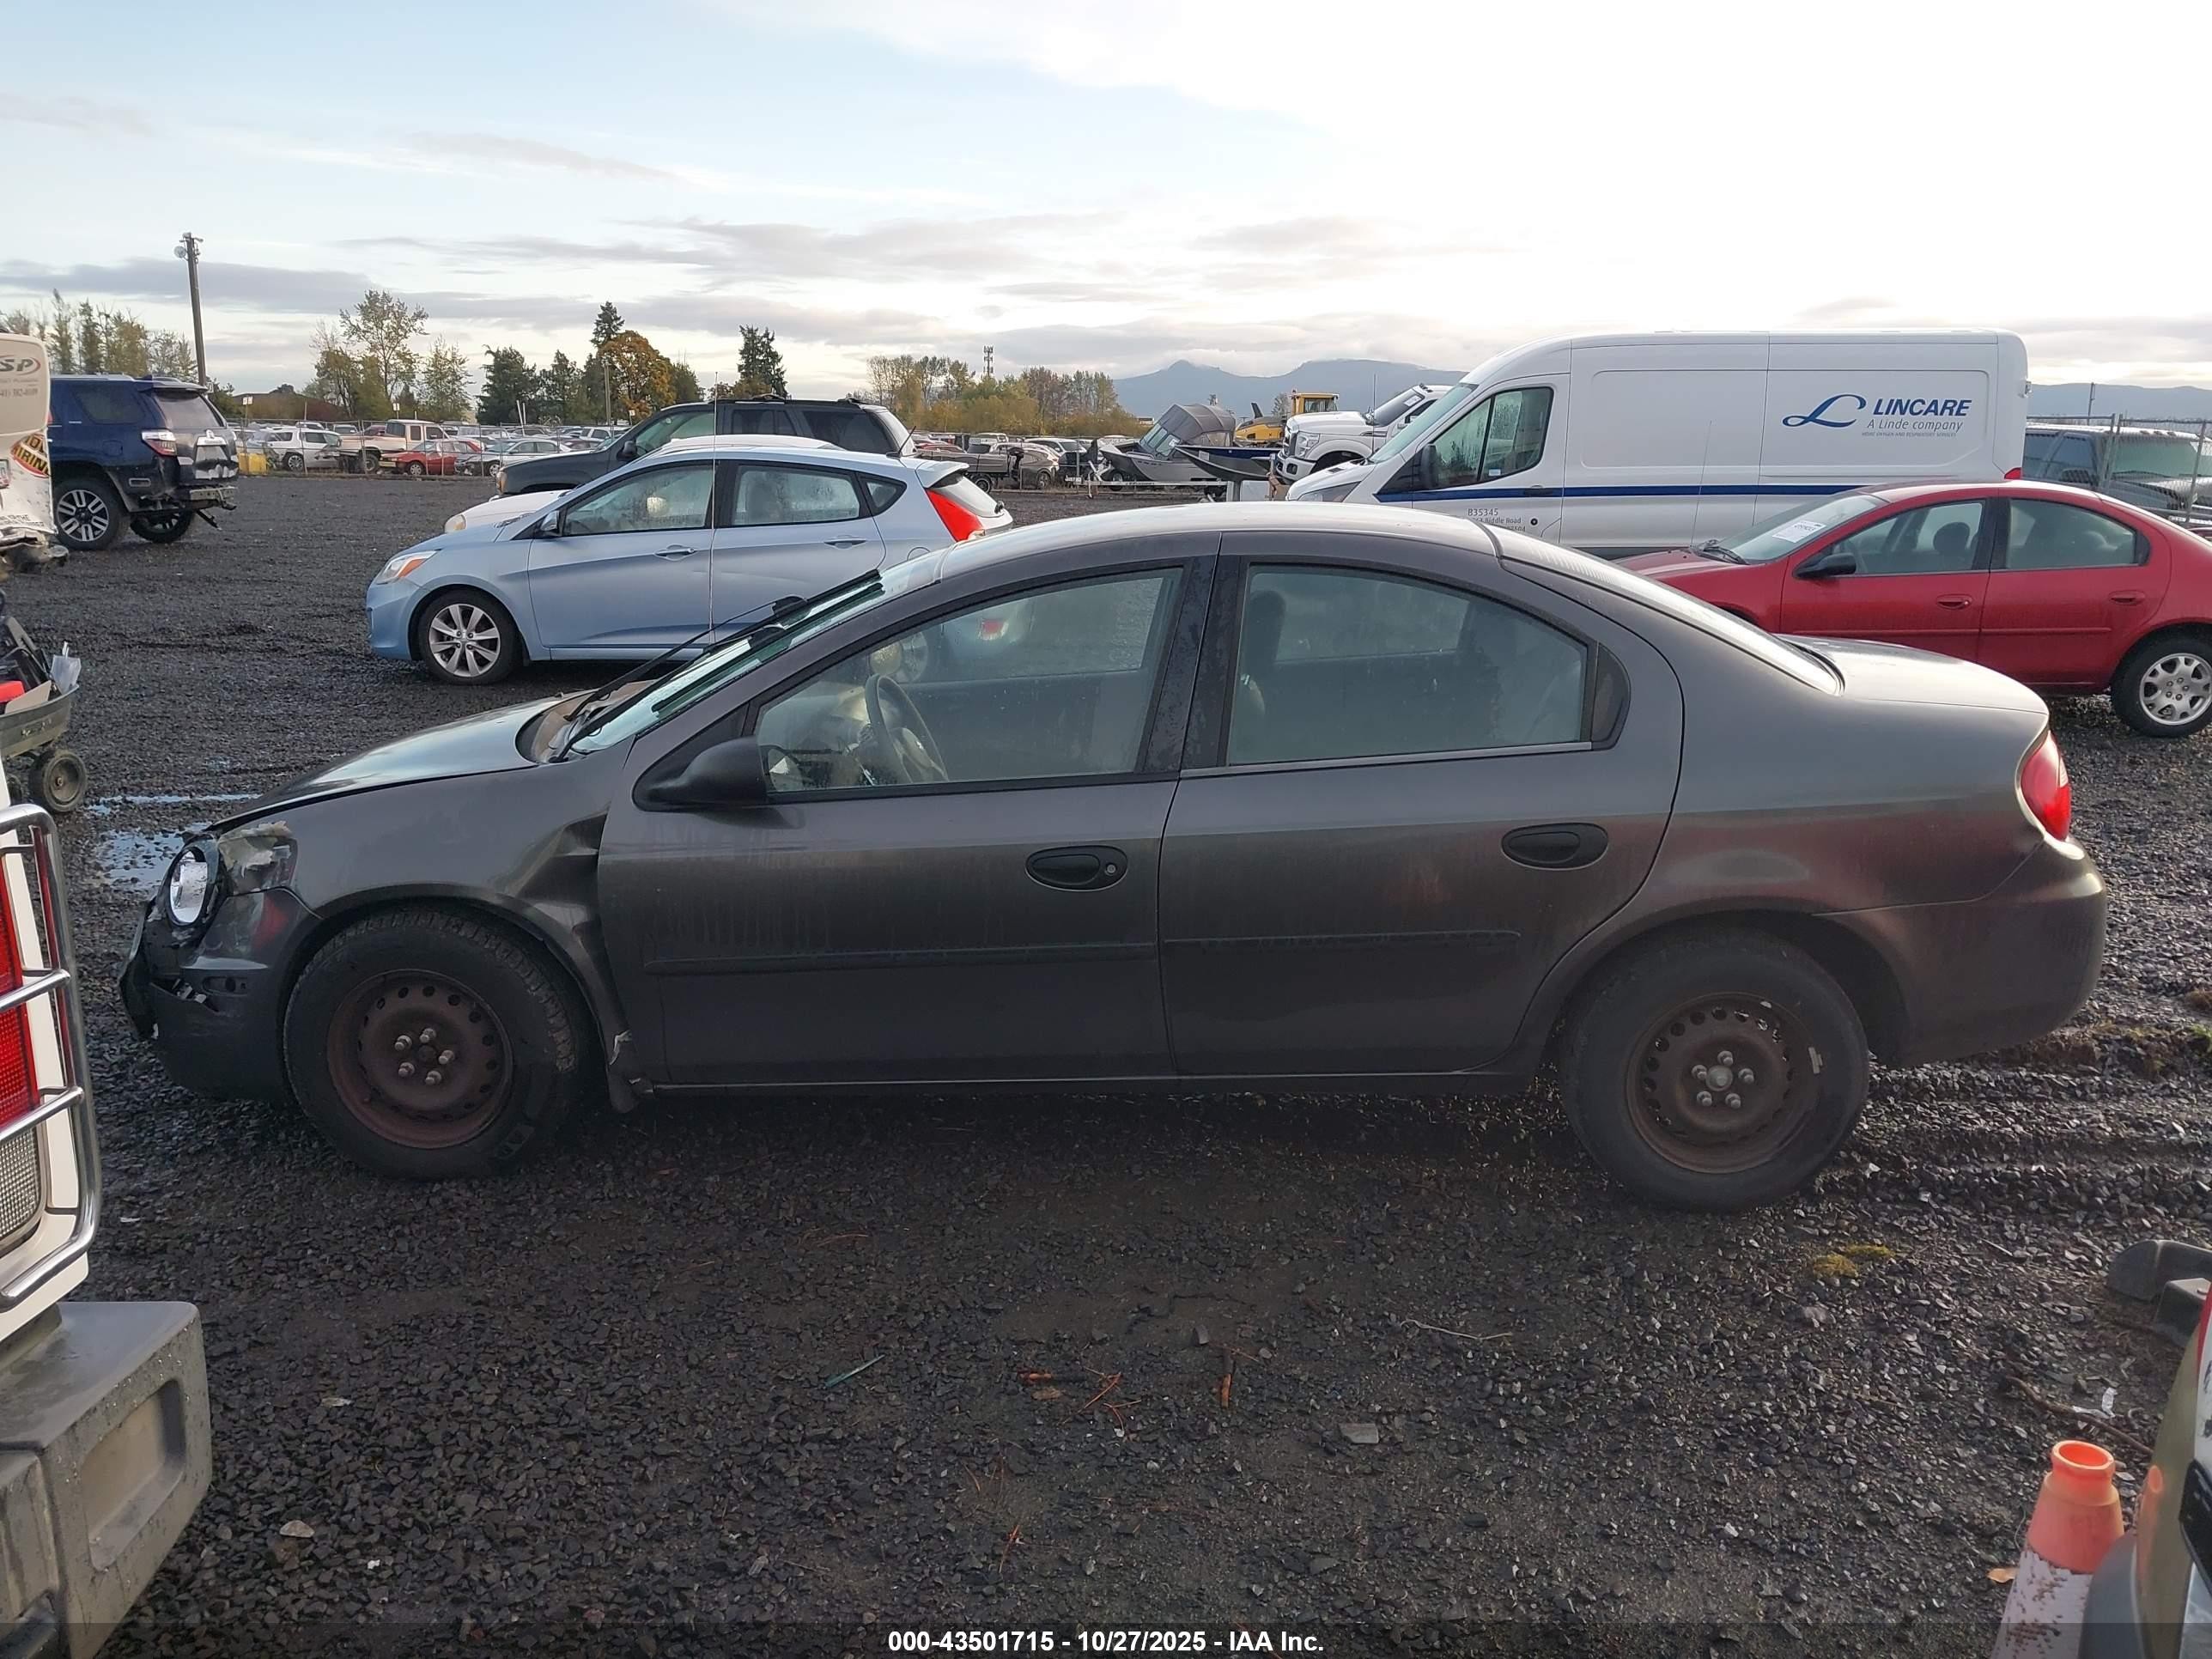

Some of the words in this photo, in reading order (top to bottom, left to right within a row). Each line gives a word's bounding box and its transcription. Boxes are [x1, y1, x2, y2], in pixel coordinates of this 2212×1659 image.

[1873, 398, 1972, 416] LINCARE
[1867, 418, 1875, 429] A
[1879, 419, 1910, 430] Linde
[1912, 420, 1964, 434] company
[1468, 508, 1498, 517] B35345
